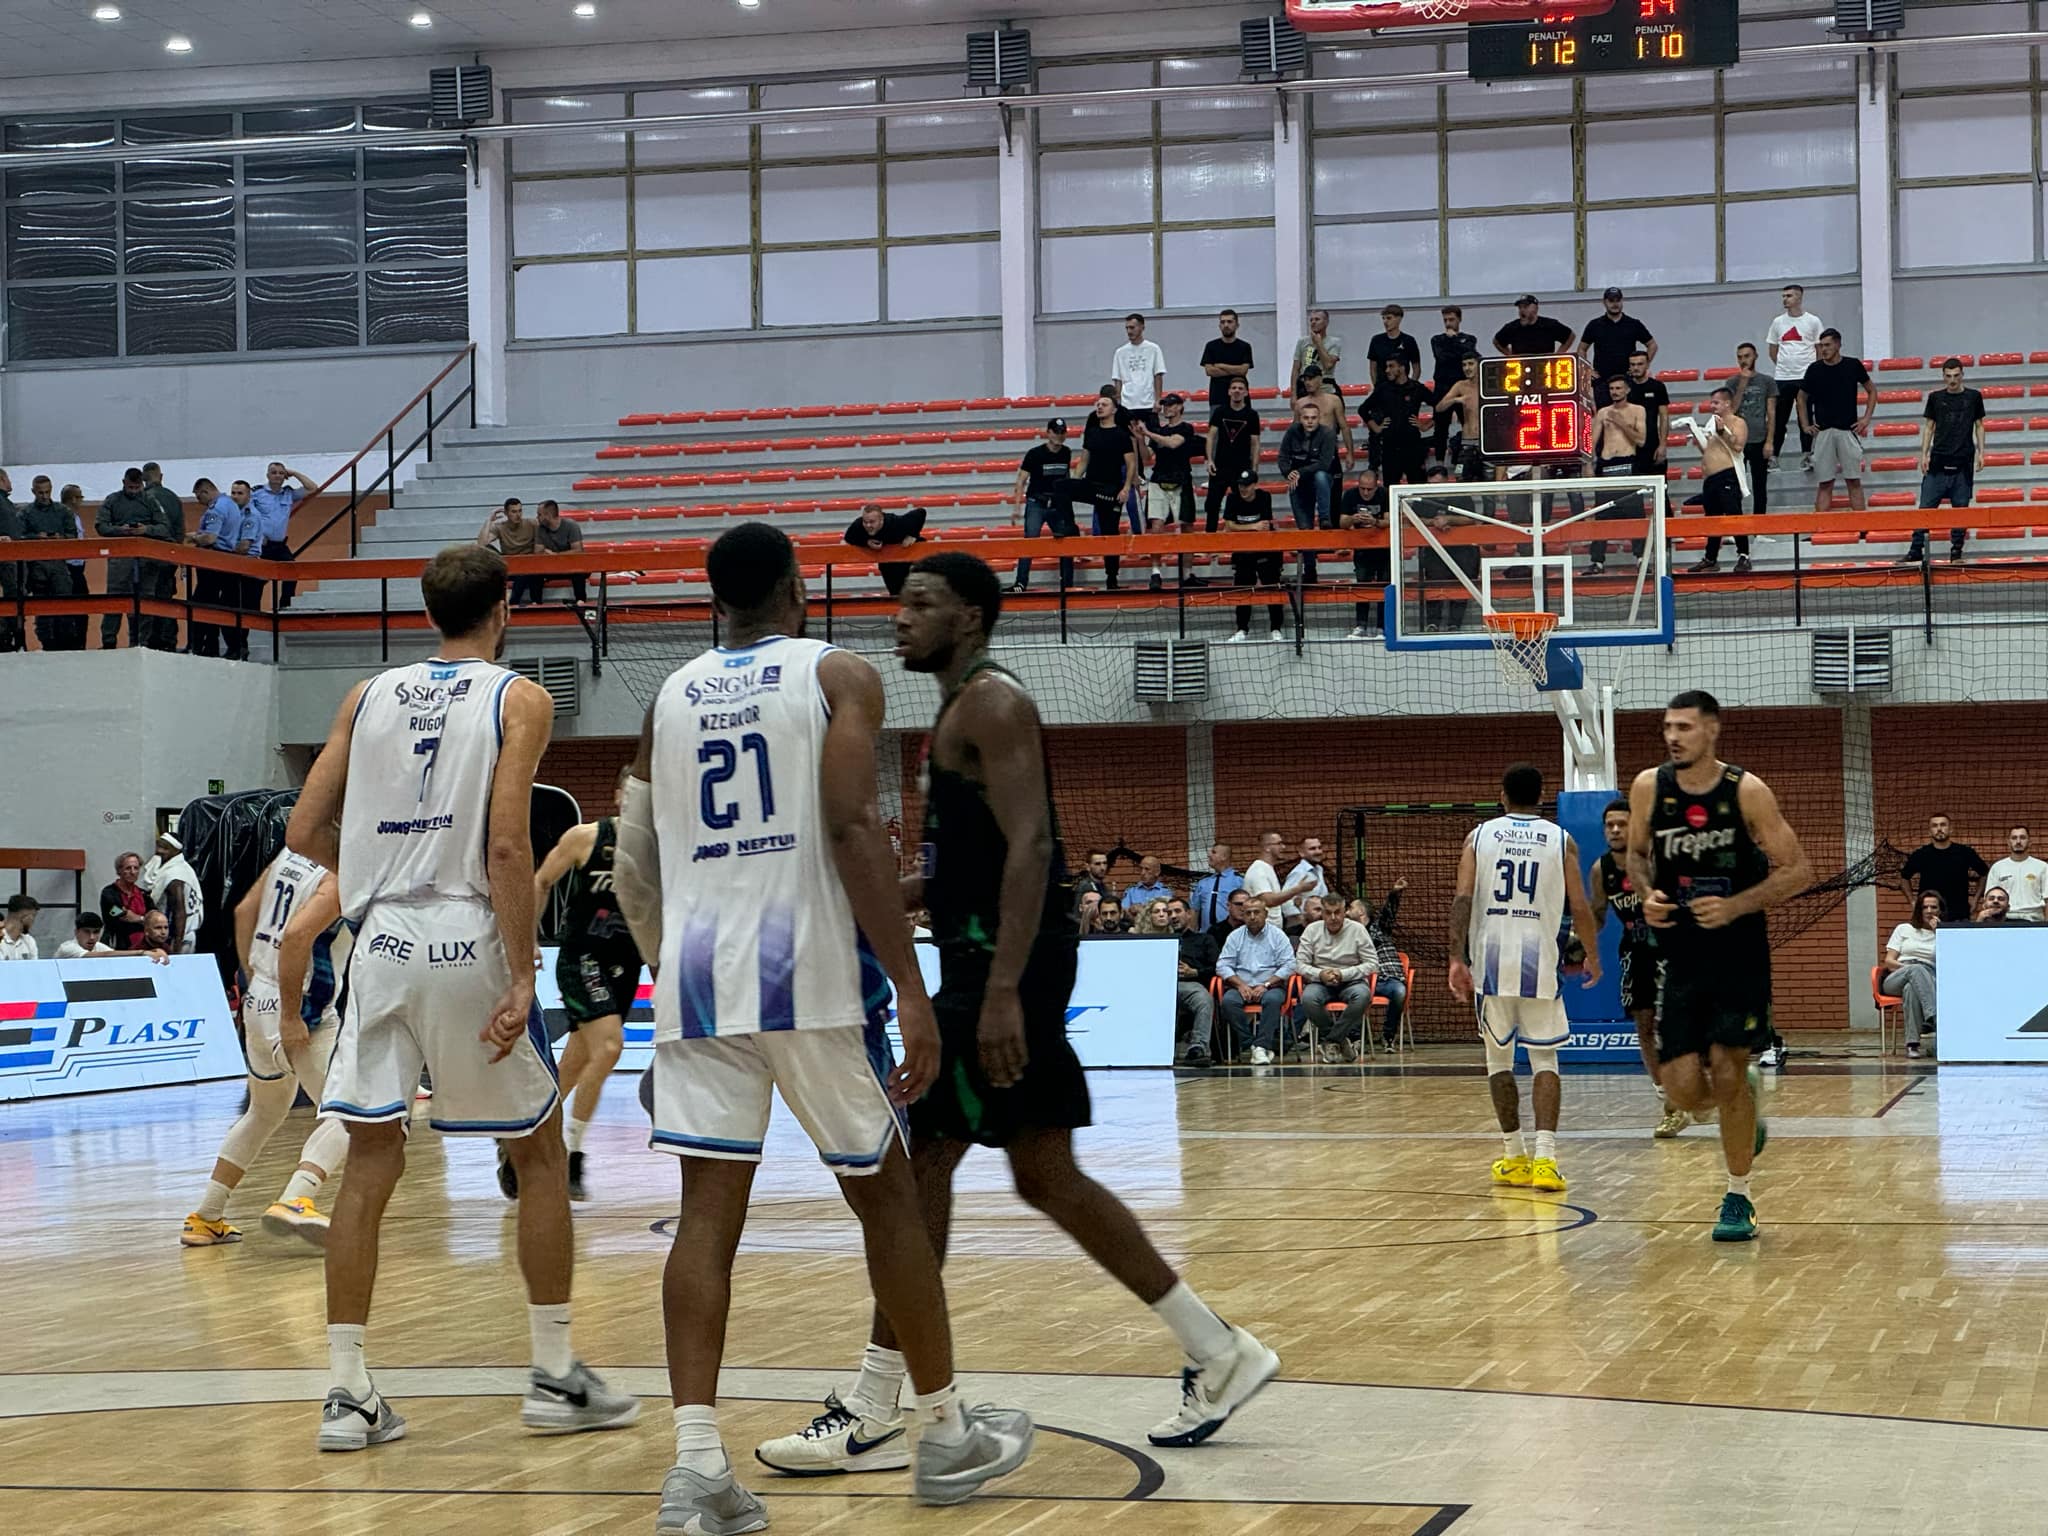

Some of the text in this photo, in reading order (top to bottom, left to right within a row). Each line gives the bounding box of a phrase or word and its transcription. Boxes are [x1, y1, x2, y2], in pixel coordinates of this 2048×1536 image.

[1528, 31, 1568, 41] PENALTY
[1591, 34, 1613, 43] FAZI
[1635, 24, 1676, 34] PENALTY
[1504, 360, 1573, 392] 2:18
[1515, 394, 1542, 405] FAZI
[1520, 408, 1574, 450] 20
[698, 732, 775, 830] 21
[1505, 847, 1533, 857] MOORE
[1494, 859, 1540, 904] 34
[1608, 892, 1642, 912] Trep
[428, 940, 477, 963] LUX
[62, 1017, 206, 1049] PLAST
[1567, 1033, 1641, 1049] RTSYSTE
